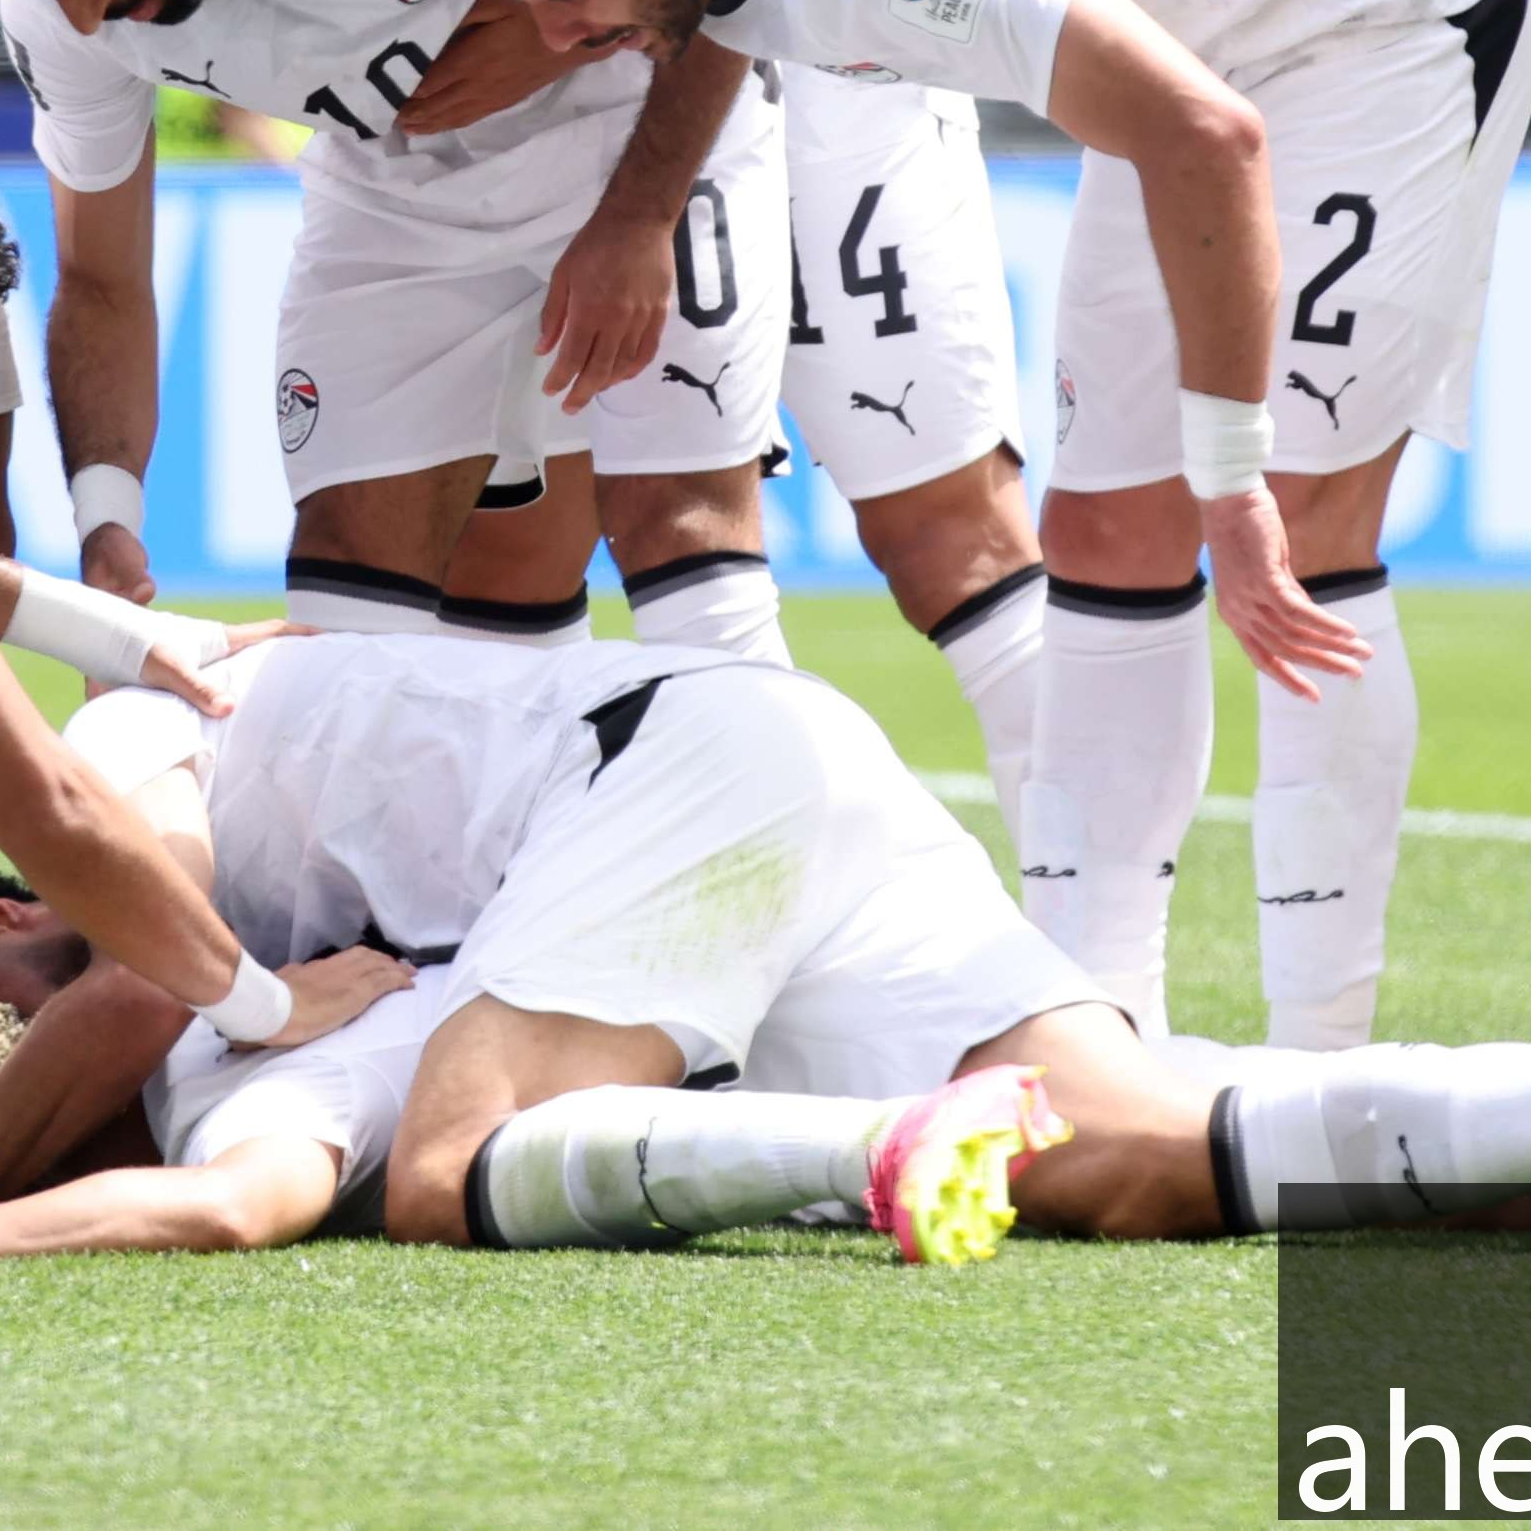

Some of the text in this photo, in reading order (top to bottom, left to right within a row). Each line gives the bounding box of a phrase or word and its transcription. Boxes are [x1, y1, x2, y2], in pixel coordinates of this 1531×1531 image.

[303, 37, 435, 142] 10
[672, 177, 739, 331] 0
[1290, 192, 1378, 348] 2
